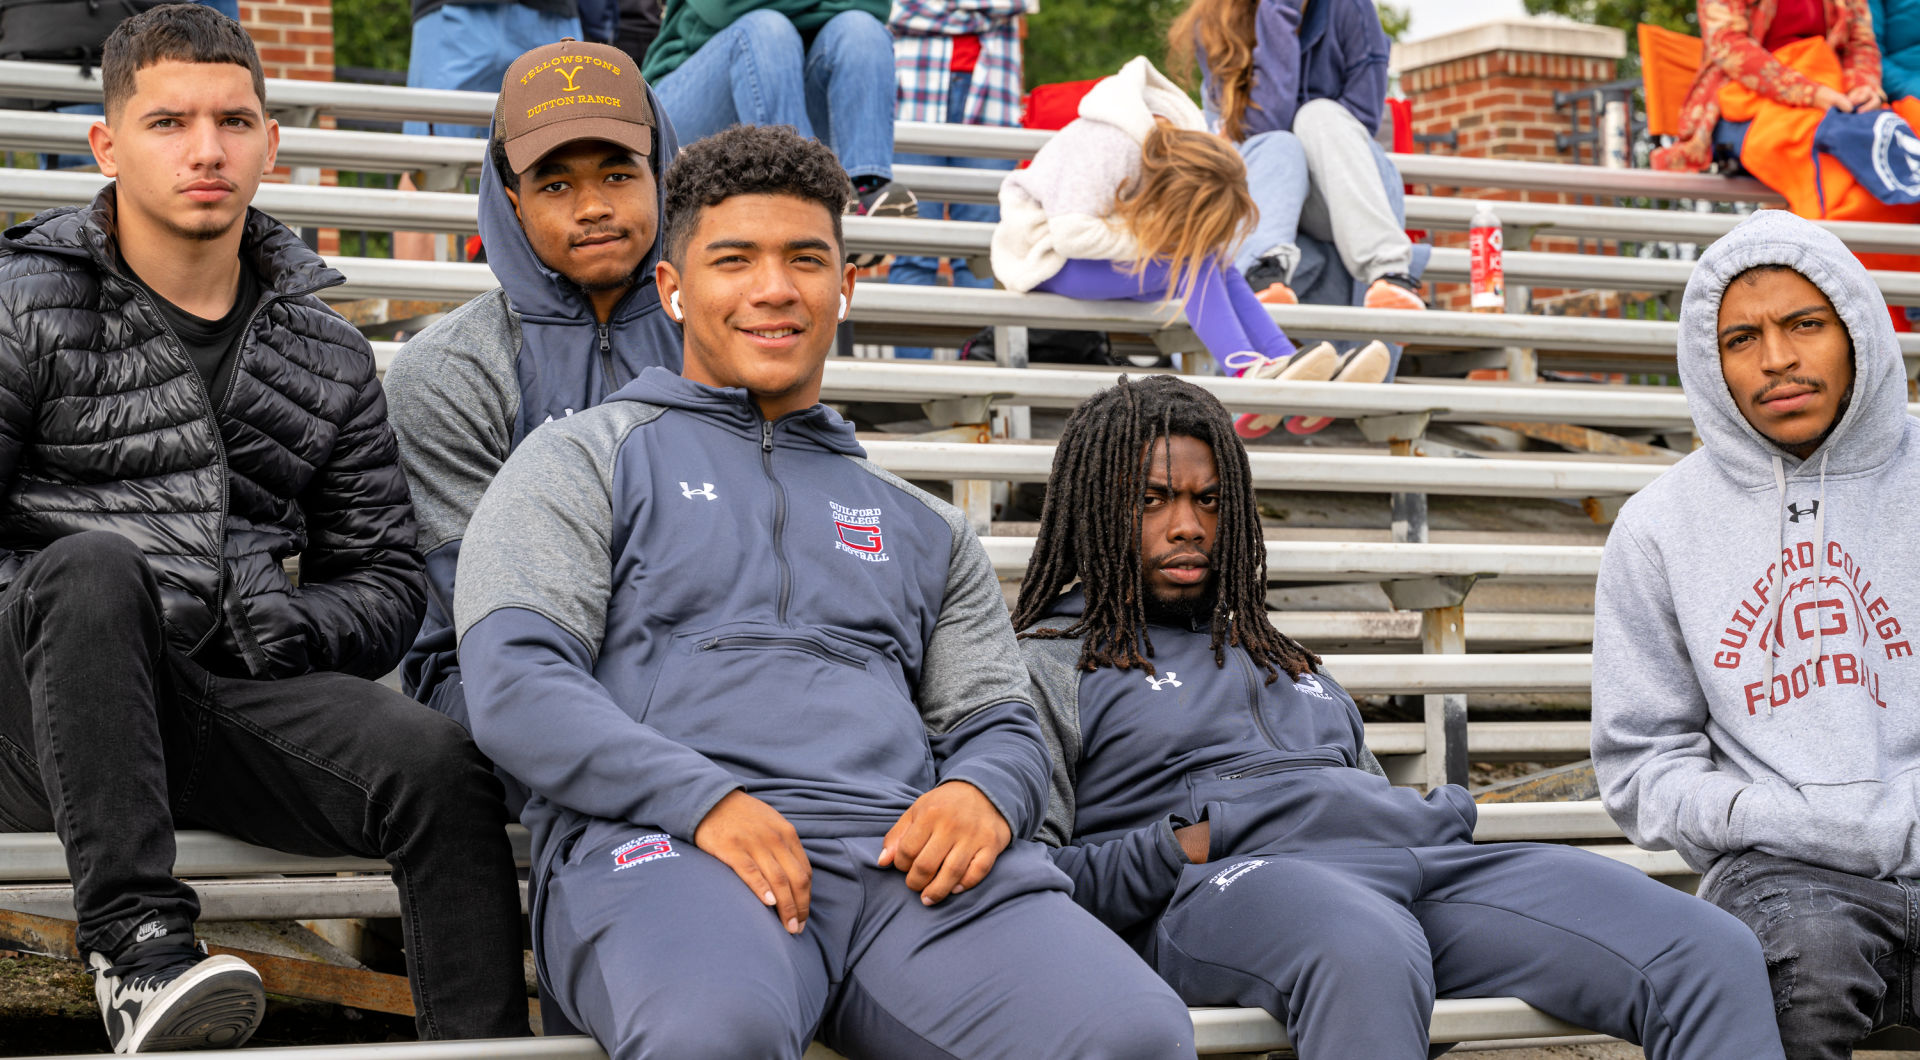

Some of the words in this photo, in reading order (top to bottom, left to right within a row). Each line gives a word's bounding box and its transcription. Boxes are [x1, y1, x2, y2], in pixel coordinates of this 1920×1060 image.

[520, 55, 621, 85] YELLOWSTONE
[527, 95, 575, 118] DUTTON
[577, 94, 621, 107] RANCH
[829, 500, 882, 517] GUILFORD
[832, 510, 880, 525] COLLEGE
[834, 520, 884, 553] G
[835, 540, 890, 562] FOOTBALL
[1827, 540, 1914, 660] COLLEGE
[1793, 598, 1848, 641] G
[139, 920, 161, 936] NIKE
[153, 928, 168, 939] AIR
